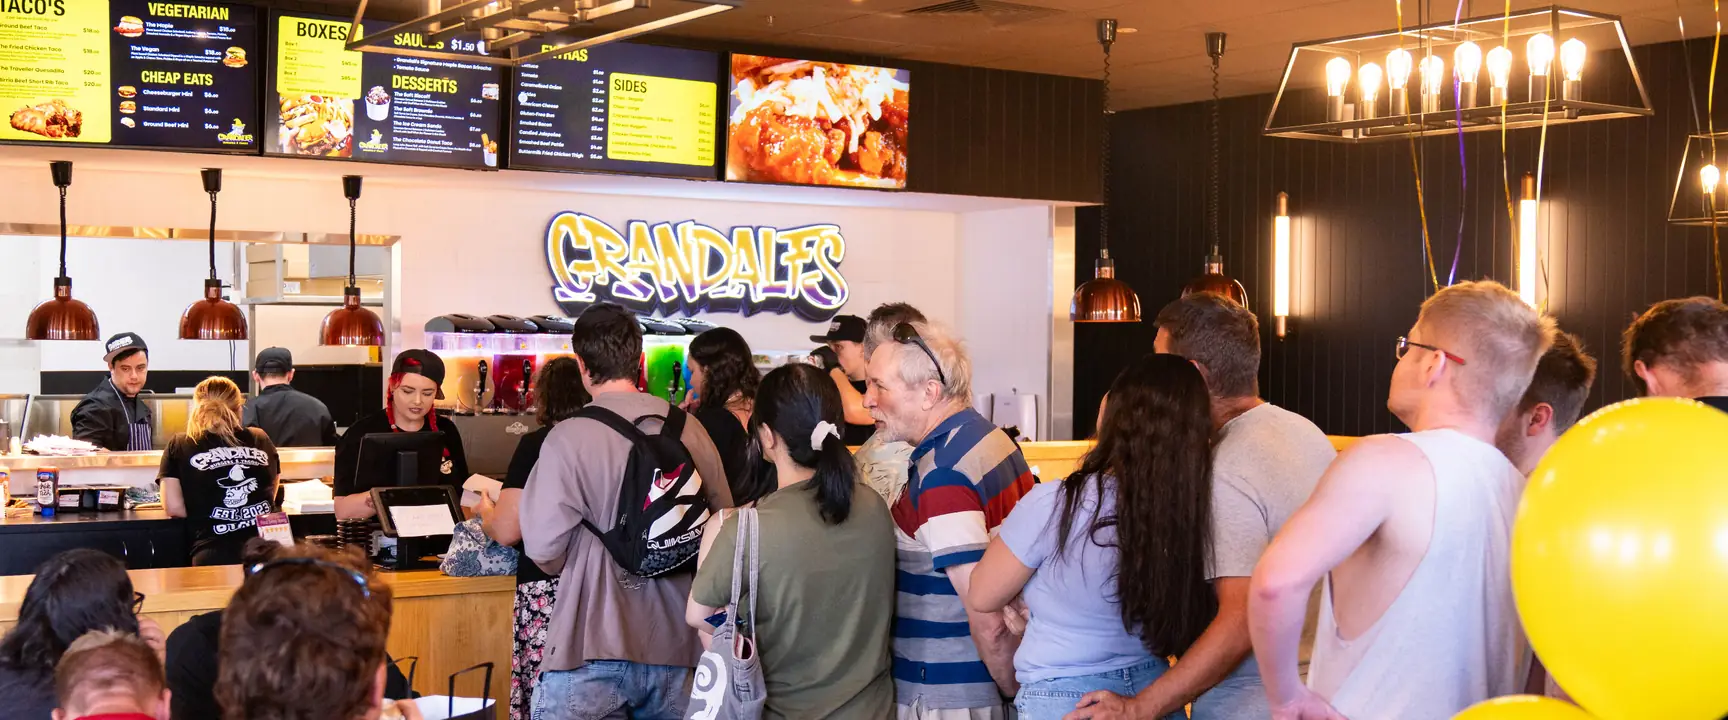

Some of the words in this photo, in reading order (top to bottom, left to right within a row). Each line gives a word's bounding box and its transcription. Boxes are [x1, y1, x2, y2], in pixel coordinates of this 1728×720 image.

[148, 2, 229, 20] VEGETARIAN
[297, 22, 347, 41] BOXES
[451, 39, 474, 51] $1.50
[142, 71, 180, 84] CHEAP
[184, 72, 213, 86] EATS
[392, 74, 458, 94] DESSERTS
[614, 79, 647, 93] SIDES
[545, 211, 849, 318] GRANDALFS
[212, 508, 241, 520] EST.
[242, 500, 270, 519] 2023
